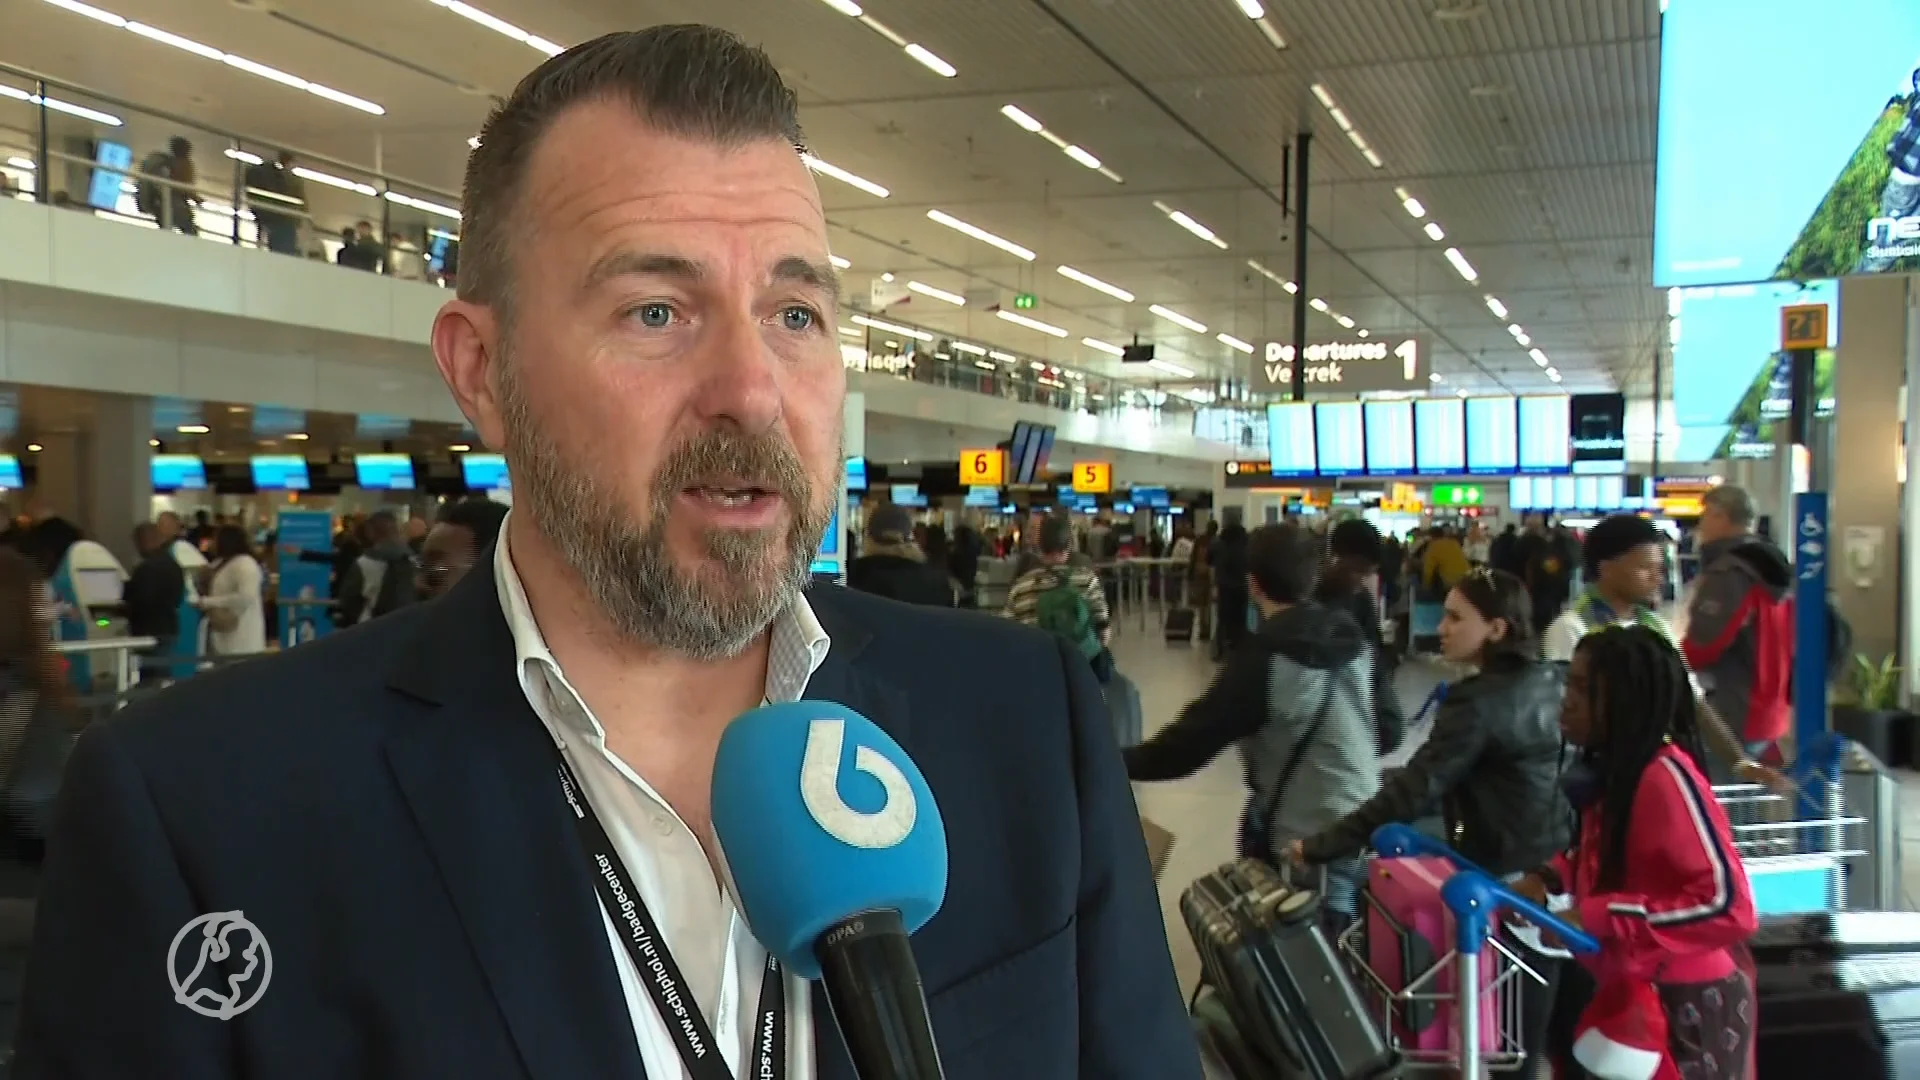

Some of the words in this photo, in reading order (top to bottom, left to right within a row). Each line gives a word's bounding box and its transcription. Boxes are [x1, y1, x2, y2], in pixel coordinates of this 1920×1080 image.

[1394, 340, 1417, 380] 1
[974, 454, 987, 474] 6
[1085, 466, 1096, 483] 5
[594, 853, 706, 1059] www.schiphol.nl/badgecenter
